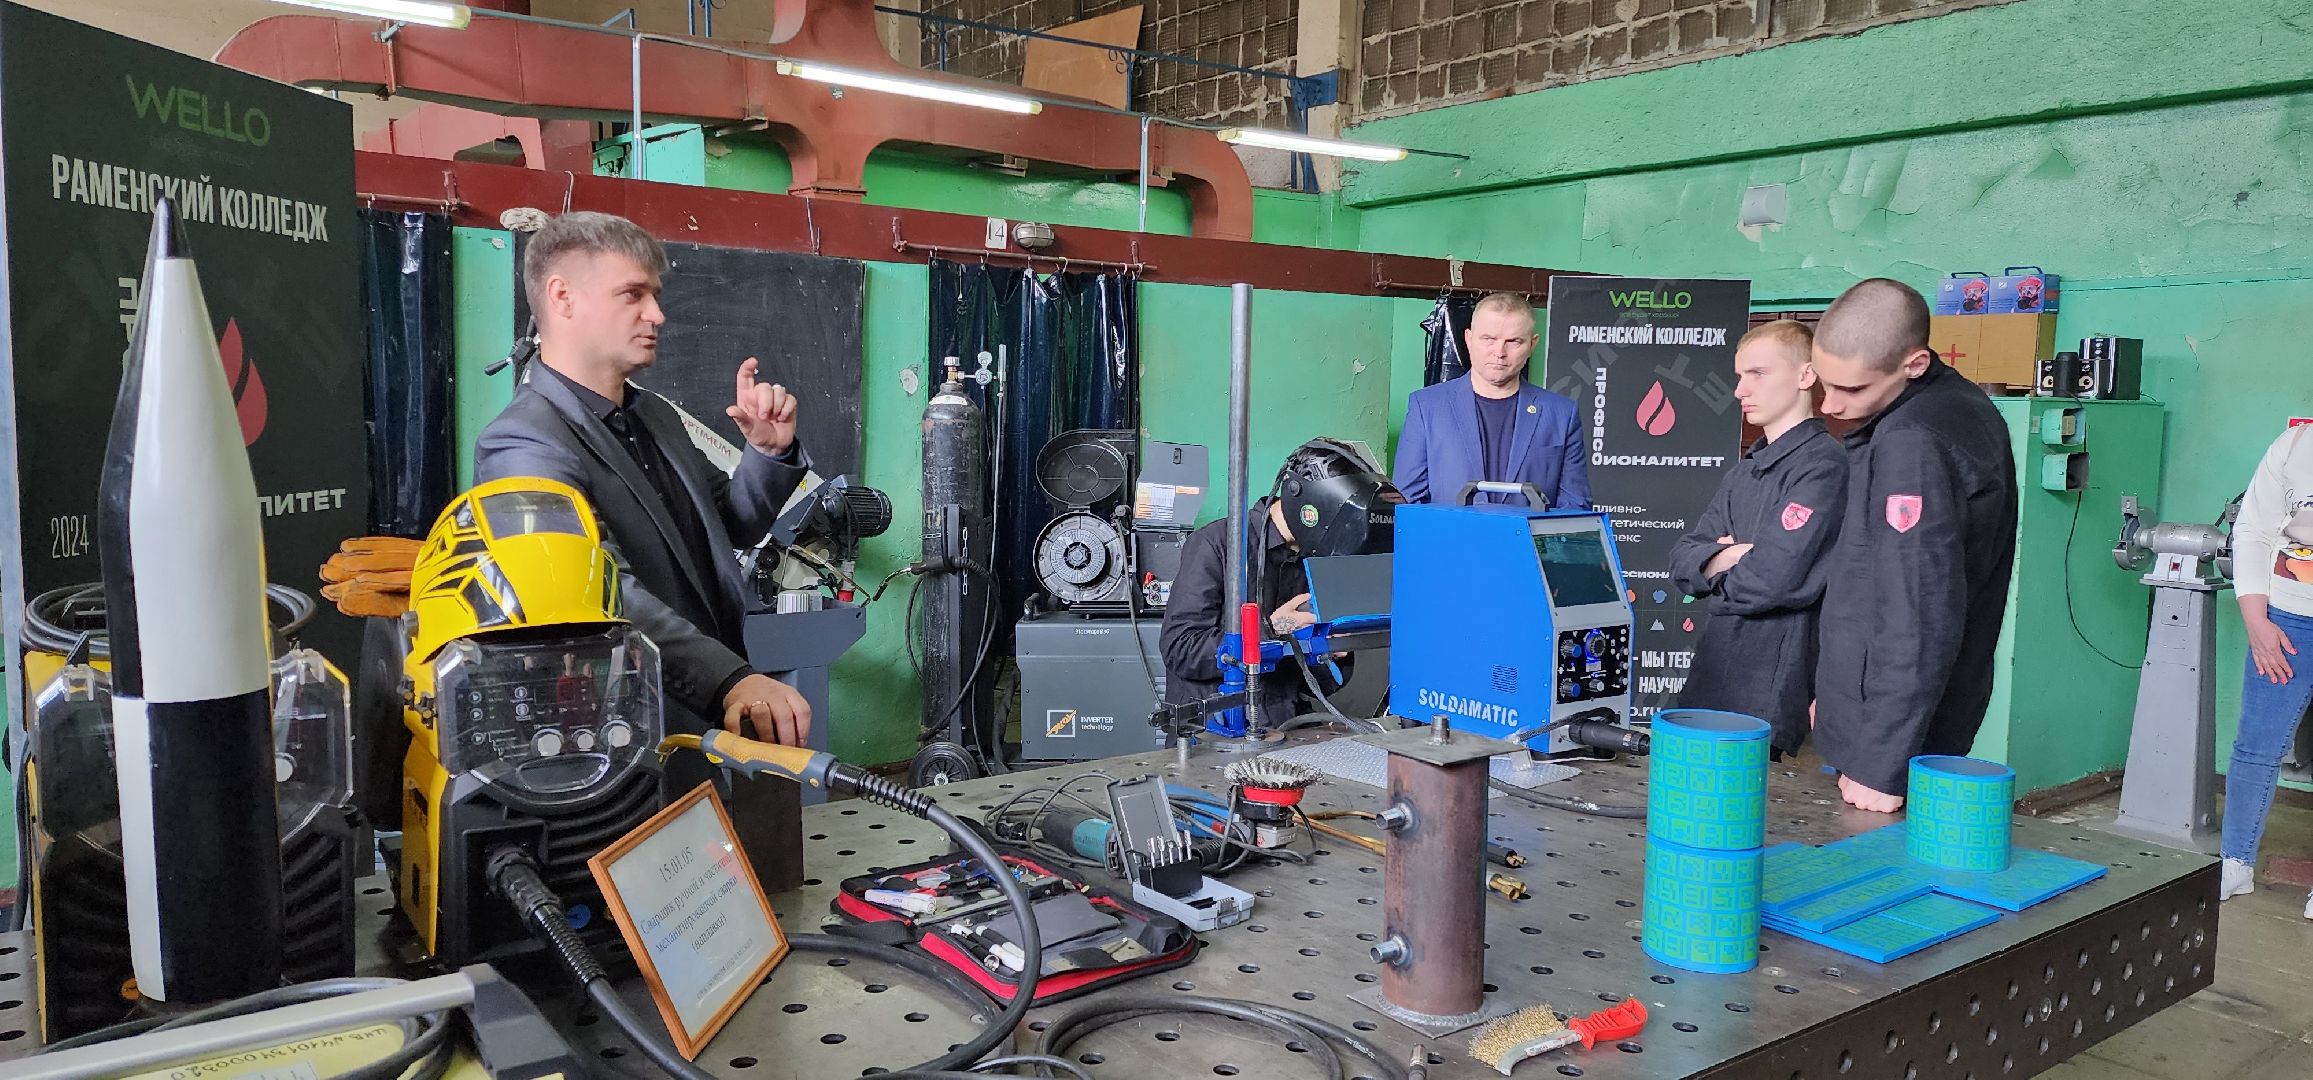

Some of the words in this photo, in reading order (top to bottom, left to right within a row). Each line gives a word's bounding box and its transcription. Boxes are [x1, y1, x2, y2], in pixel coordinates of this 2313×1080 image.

[126, 74, 271, 147] WELLO
[220, 186, 329, 243] КОЛЛЕДЖ
[1609, 290, 1693, 309] WELLO
[1568, 324, 1653, 344] РАМЕНСКИЙ
[1656, 327, 1727, 346] КОЛЛЕДЖ
[50, 514, 90, 559] 2024
[1641, 650, 1665, 668] МЫ
[1668, 651, 1696, 669] ТЕБ
[1638, 676, 1688, 694] НАУЧИ
[1418, 688, 1519, 727] SOLDAMATIC
[658, 846, 695, 883] 15.01.05
